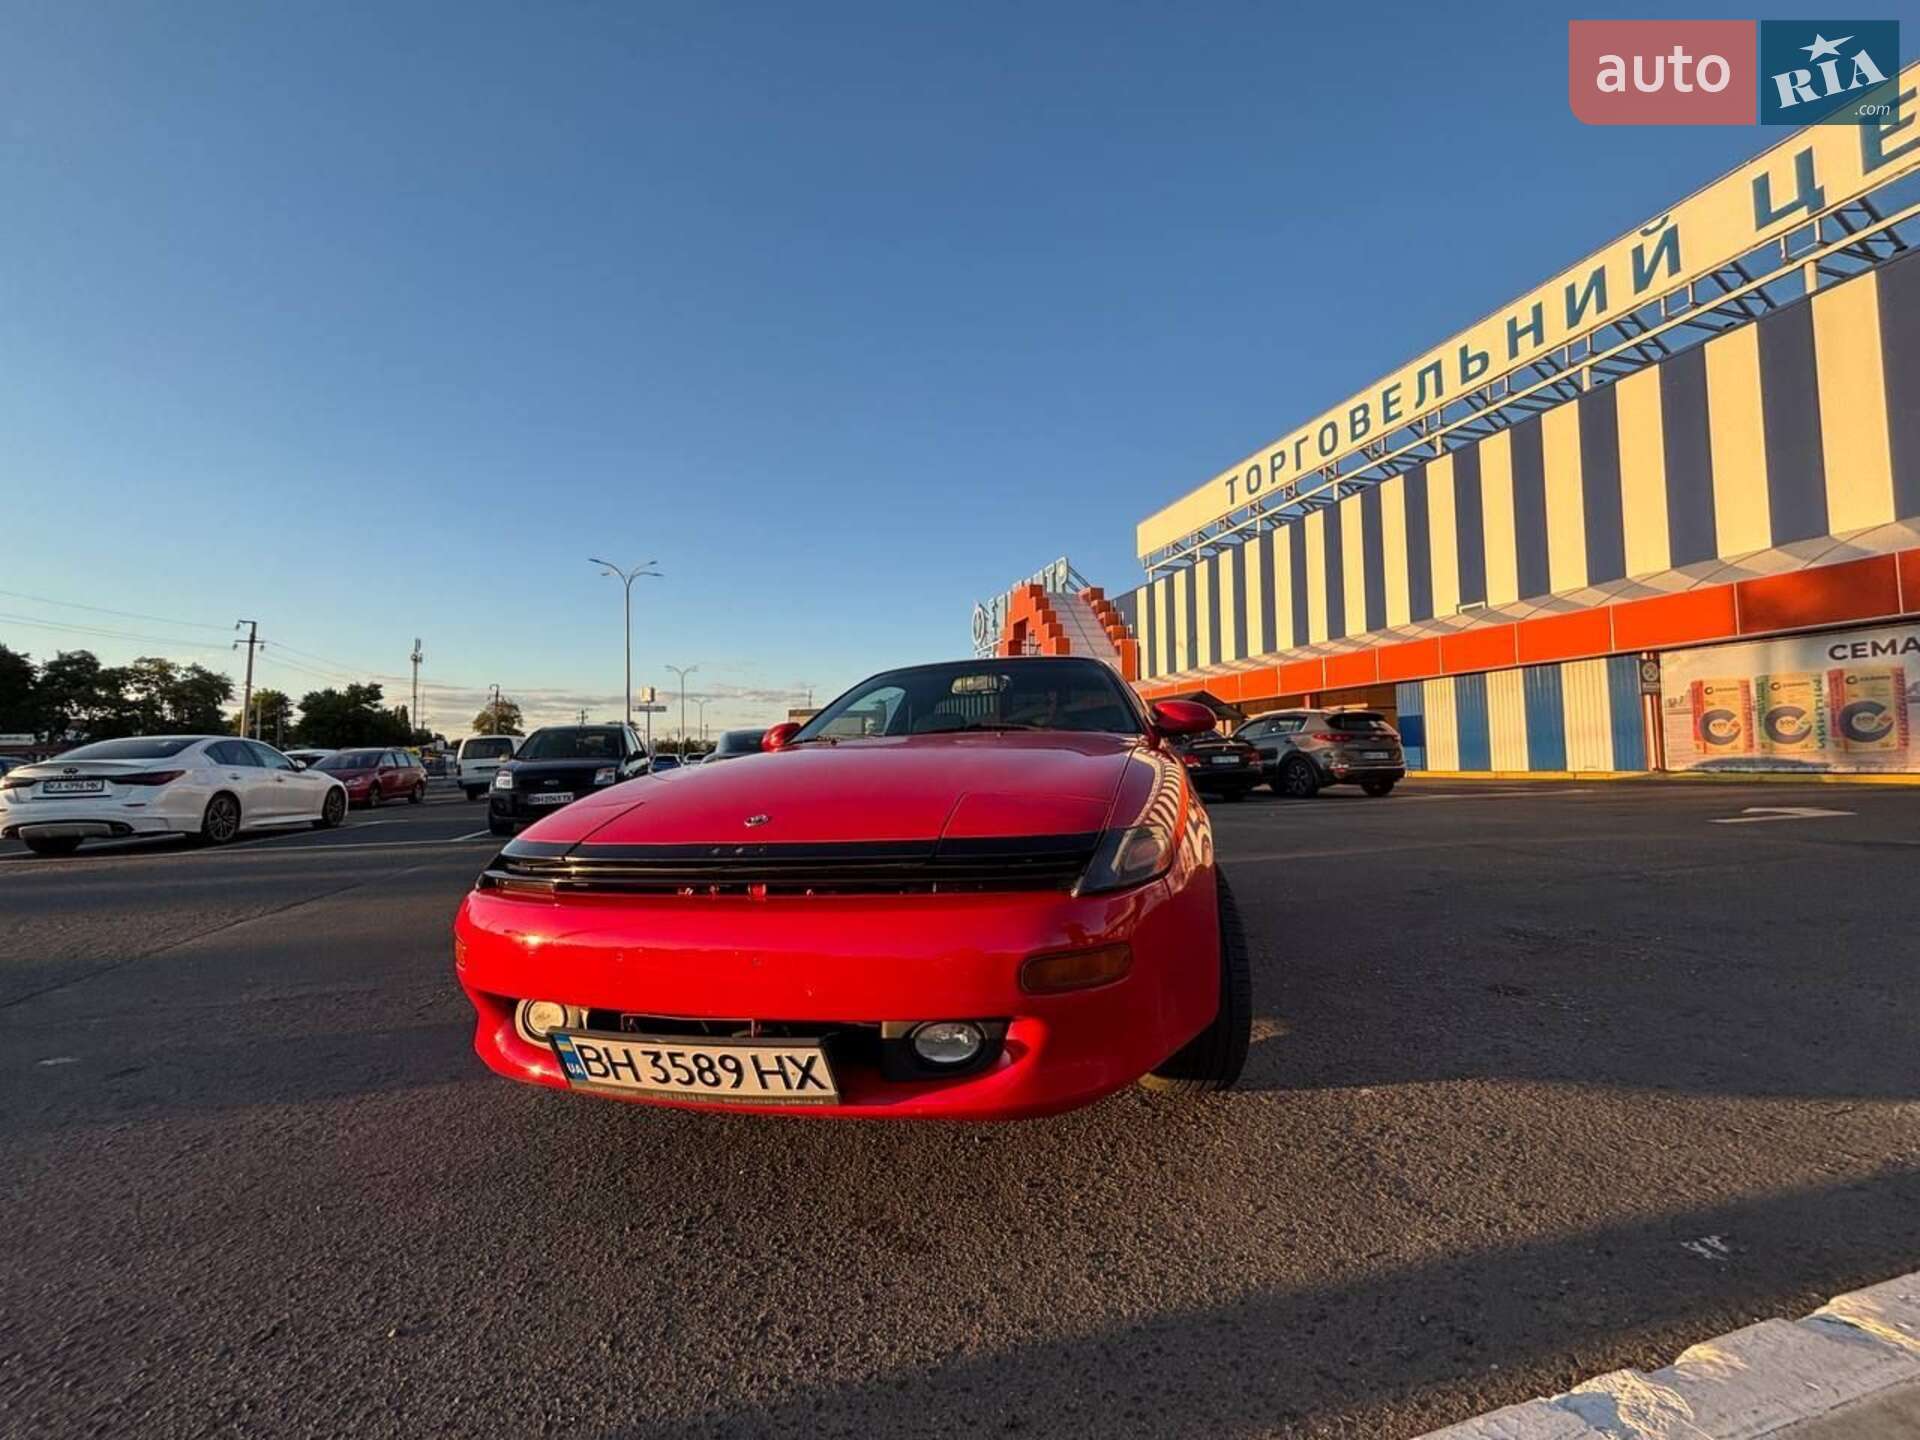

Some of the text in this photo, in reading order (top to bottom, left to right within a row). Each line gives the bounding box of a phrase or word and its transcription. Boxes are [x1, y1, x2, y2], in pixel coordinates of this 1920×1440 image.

[1224, 215, 1683, 506] ТОРГОВЕЛЬНИЙ
[566, 1062, 584, 1076] UA
[575, 1044, 829, 1090] BH 3589 HX
